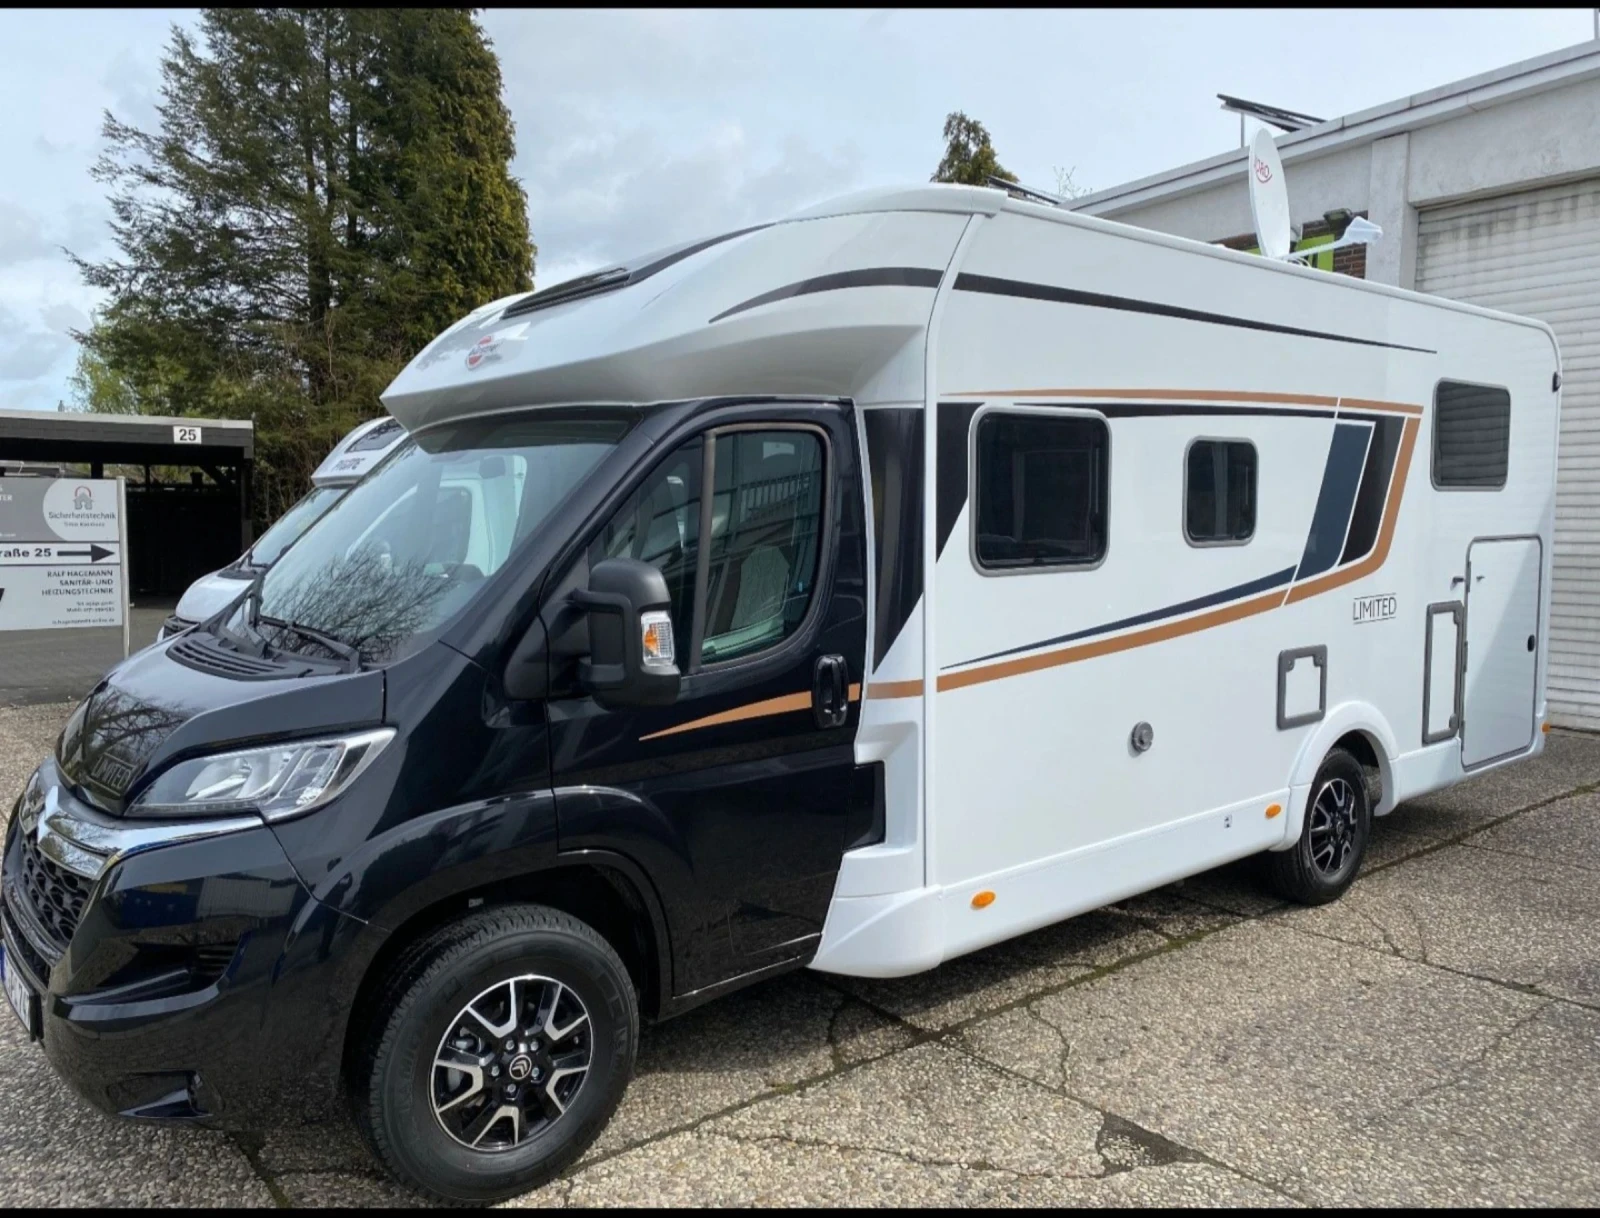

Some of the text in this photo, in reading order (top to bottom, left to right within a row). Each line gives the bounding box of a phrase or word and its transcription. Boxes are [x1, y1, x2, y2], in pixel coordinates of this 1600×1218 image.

[179, 428, 197, 441] 25
[48, 511, 116, 520] Sicherheitstechnik
[34, 548, 52, 557] 25
[41, 588, 114, 596] HEIZUNGSTECHNIK
[1353, 597, 1397, 620] LIMITED
